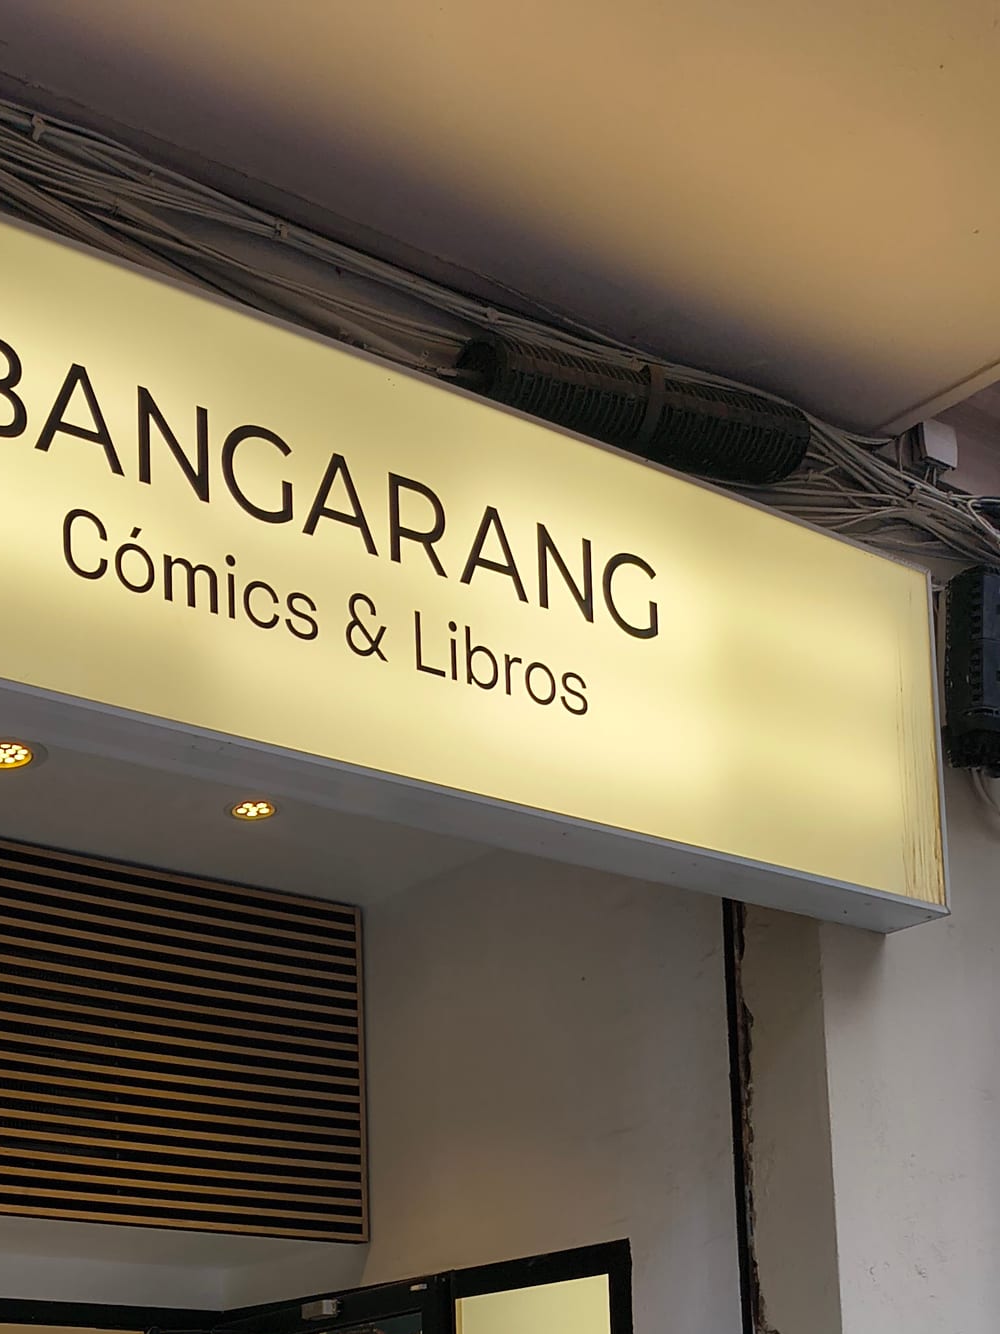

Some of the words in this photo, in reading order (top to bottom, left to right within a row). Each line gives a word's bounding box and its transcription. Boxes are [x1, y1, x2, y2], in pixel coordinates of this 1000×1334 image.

[62, 507, 319, 643] Cómics
[345, 592, 389, 663] &
[414, 608, 589, 716] Libros
